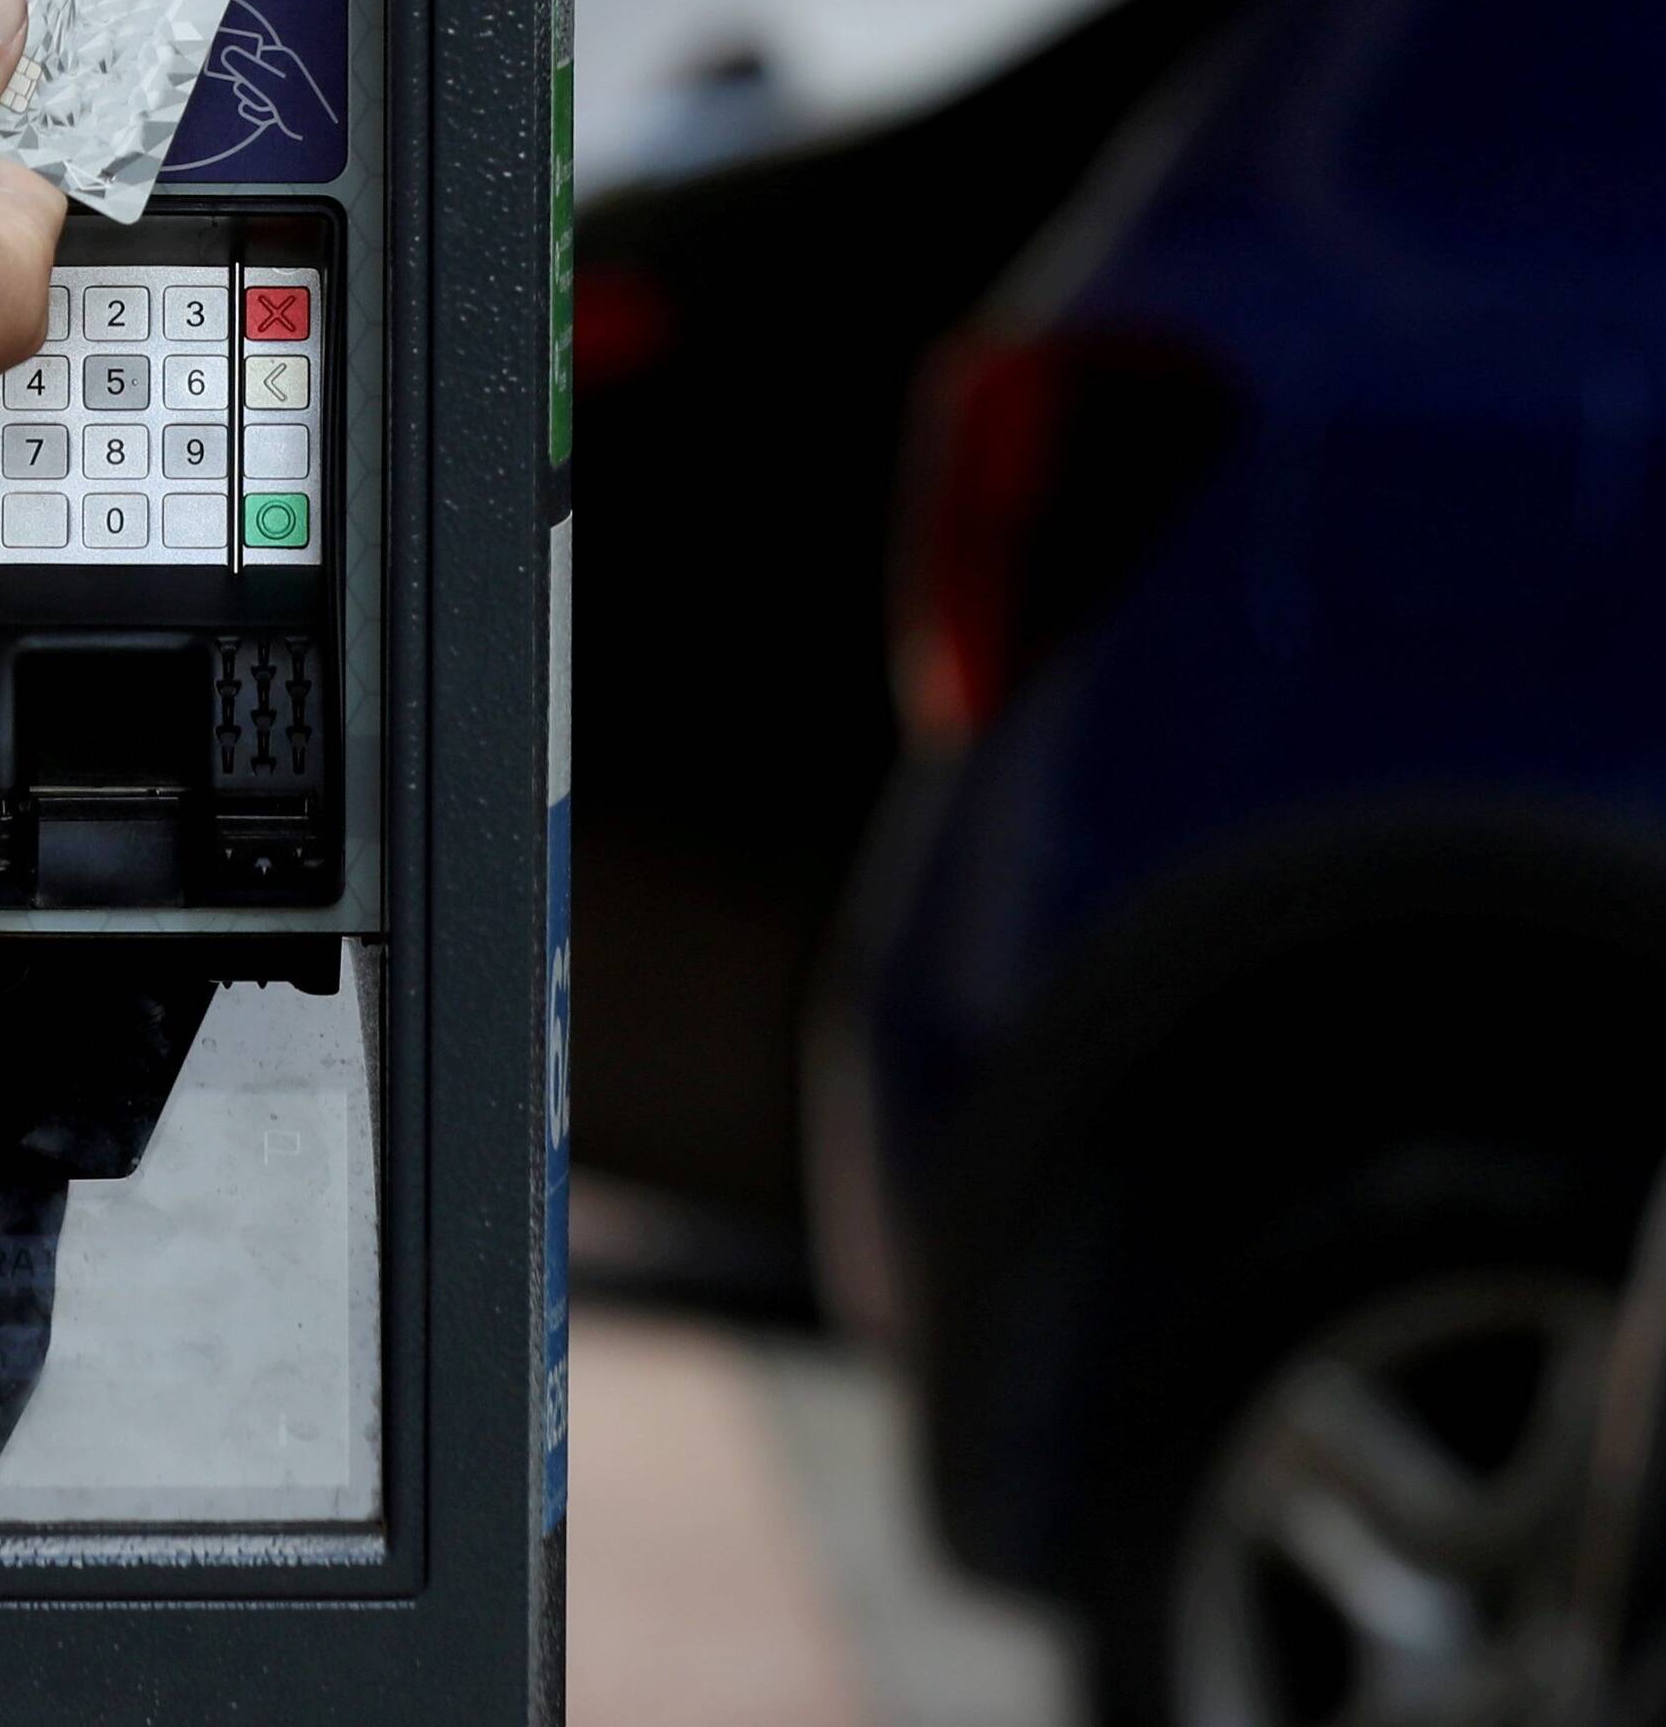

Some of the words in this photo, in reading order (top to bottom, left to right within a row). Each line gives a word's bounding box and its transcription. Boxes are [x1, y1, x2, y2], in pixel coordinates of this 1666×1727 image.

[107, 300, 125, 327] 2
[186, 300, 205, 327] 3
[26, 369, 45, 395] 4
[107, 368, 125, 395] 5
[187, 369, 205, 395] 6
[25, 438, 44, 466] 7
[106, 438, 125, 465] 8
[186, 438, 205, 465] 9
[106, 507, 124, 534] 0
